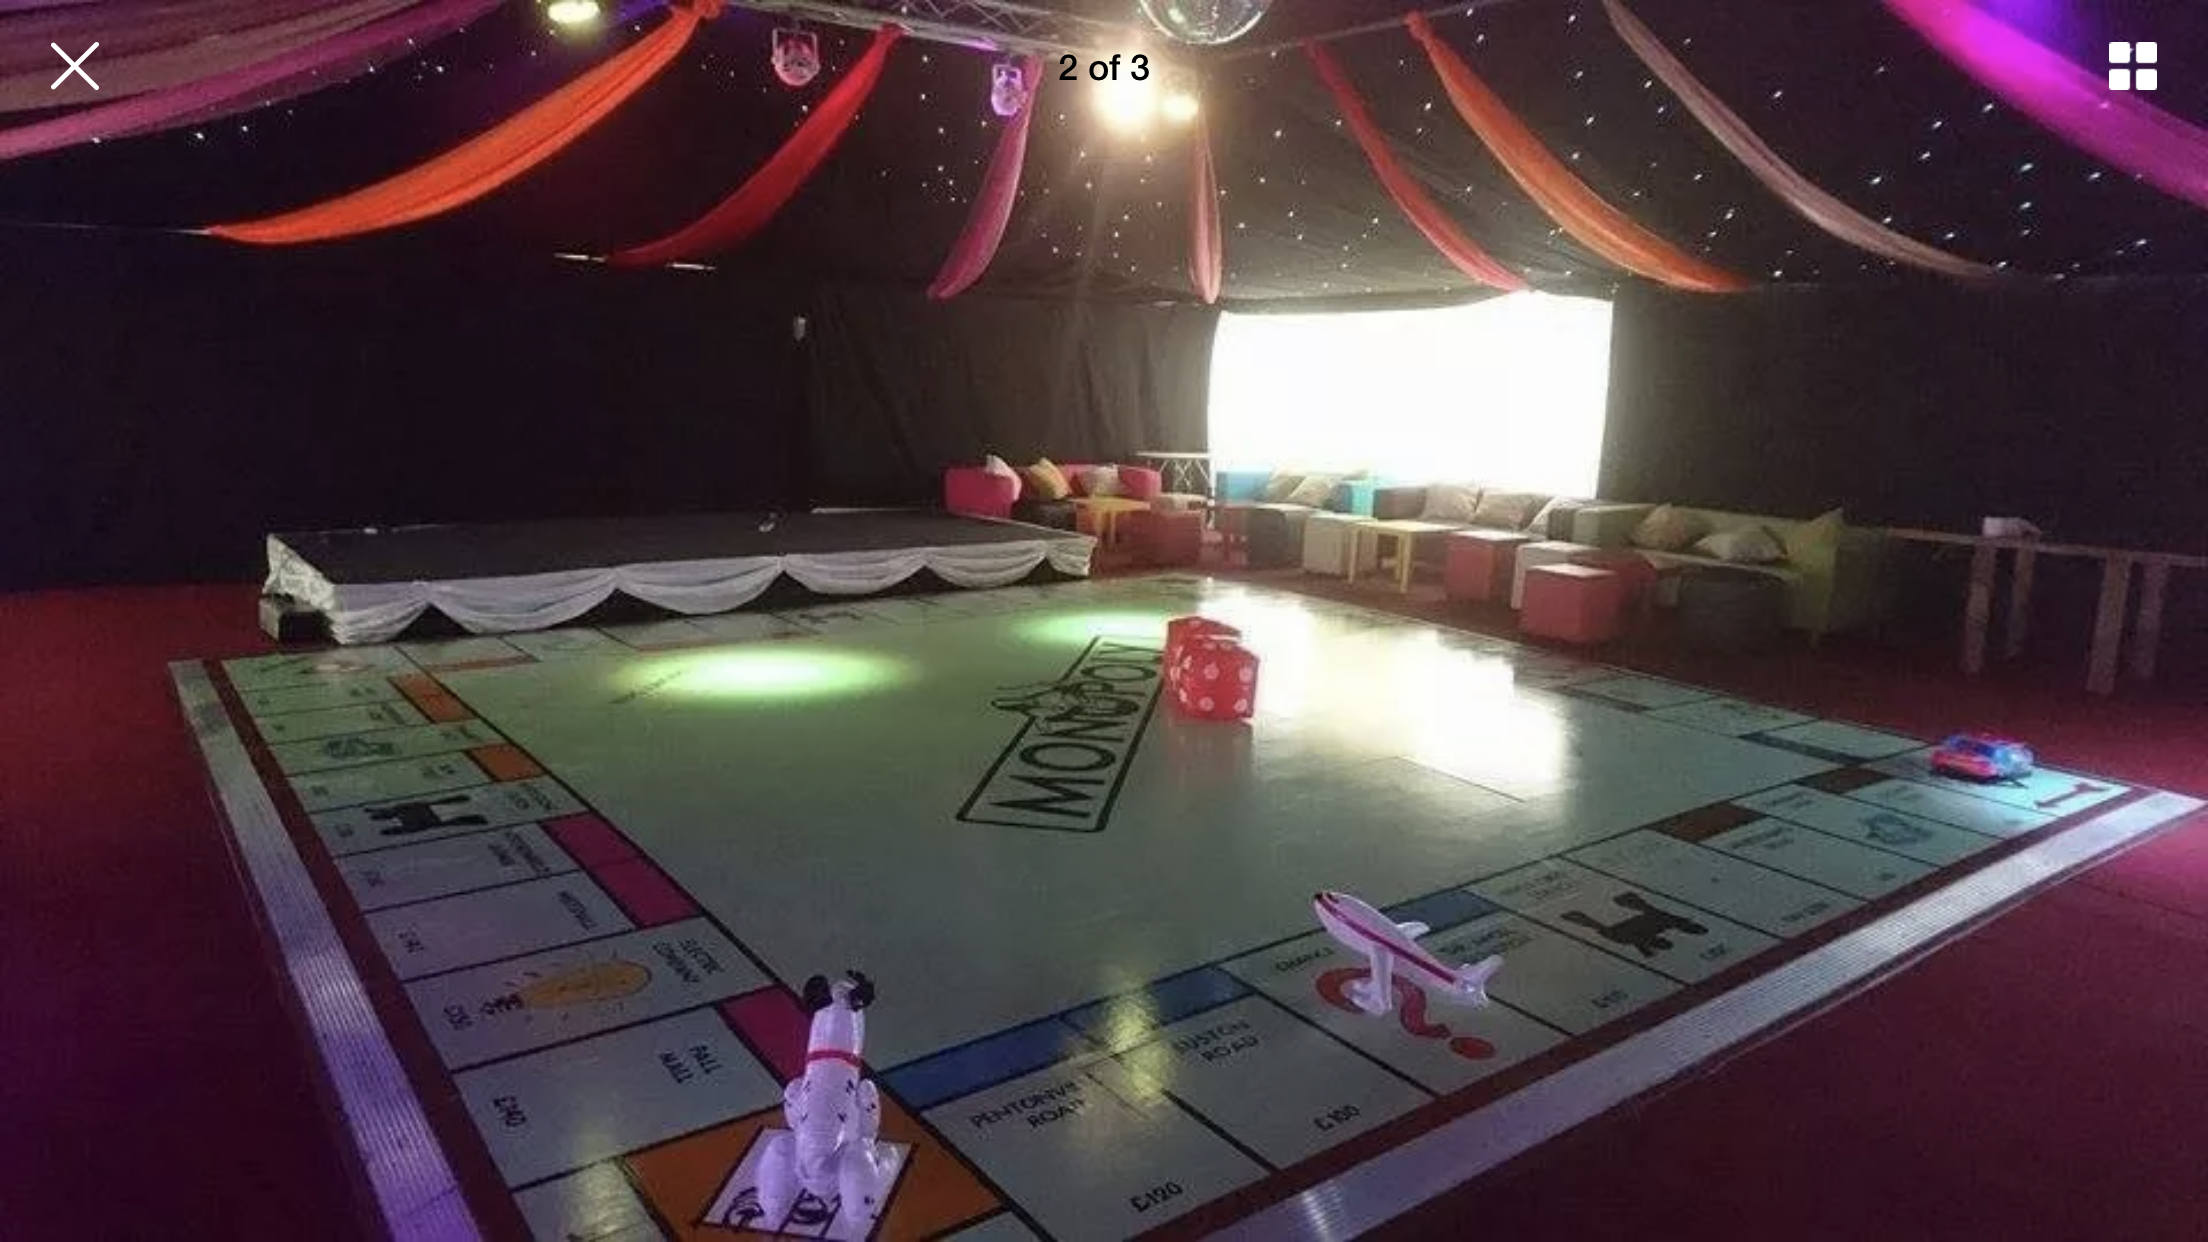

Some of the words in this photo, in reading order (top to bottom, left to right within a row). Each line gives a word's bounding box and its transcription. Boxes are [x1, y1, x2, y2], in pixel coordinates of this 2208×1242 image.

[989, 641, 1165, 818] MONOPOLY
[690, 1044, 723, 1075] PALL
[1200, 1035, 1260, 1063] ROAD
[659, 1051, 694, 1085] MALL
[1130, 1181, 1183, 1214] £120
